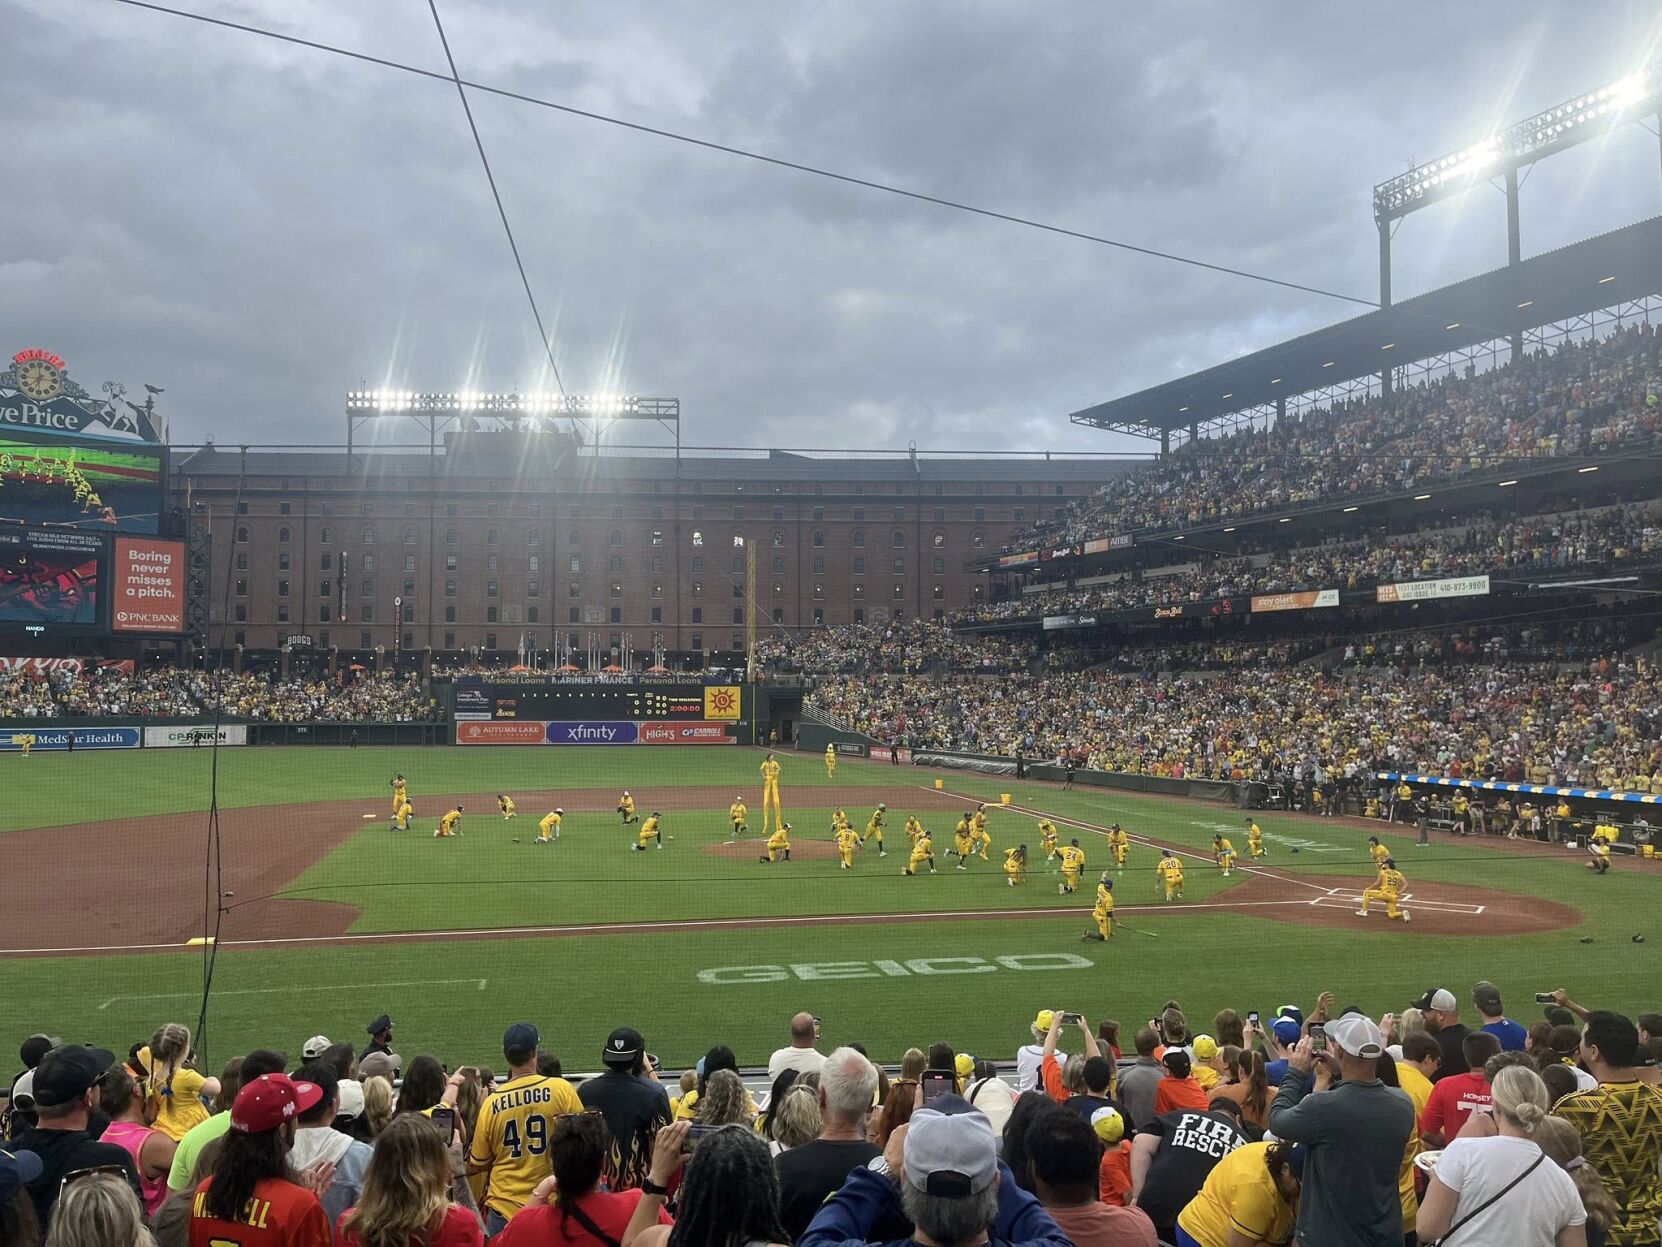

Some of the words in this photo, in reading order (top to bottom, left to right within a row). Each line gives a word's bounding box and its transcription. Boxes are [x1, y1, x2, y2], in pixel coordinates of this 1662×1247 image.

[20, 403, 79, 430] Price
[129, 550, 171, 564] Boring
[131, 564, 169, 573] never
[127, 574, 172, 586] misses
[126, 588, 135, 596] a
[138, 586, 175, 599] pitch.
[129, 613, 151, 622] PNC
[152, 613, 180, 623] BANK
[482, 677, 519, 685] Personal
[520, 677, 546, 685] Loans
[639, 677, 675, 685] Personal
[677, 677, 701, 685] Loans
[38, 732, 84, 744] MedSar
[86, 733, 123, 744] Health
[186, 731, 227, 741] RNKN
[567, 724, 617, 741] xfinity
[646, 729, 676, 740] HIGH'S
[1066, 850, 1077, 861] 24
[1165, 860, 1177, 869] 20
[696, 952, 1095, 984] GEICO
[492, 1087, 551, 1115] KELLOGG
[502, 1114, 548, 1159] 49
